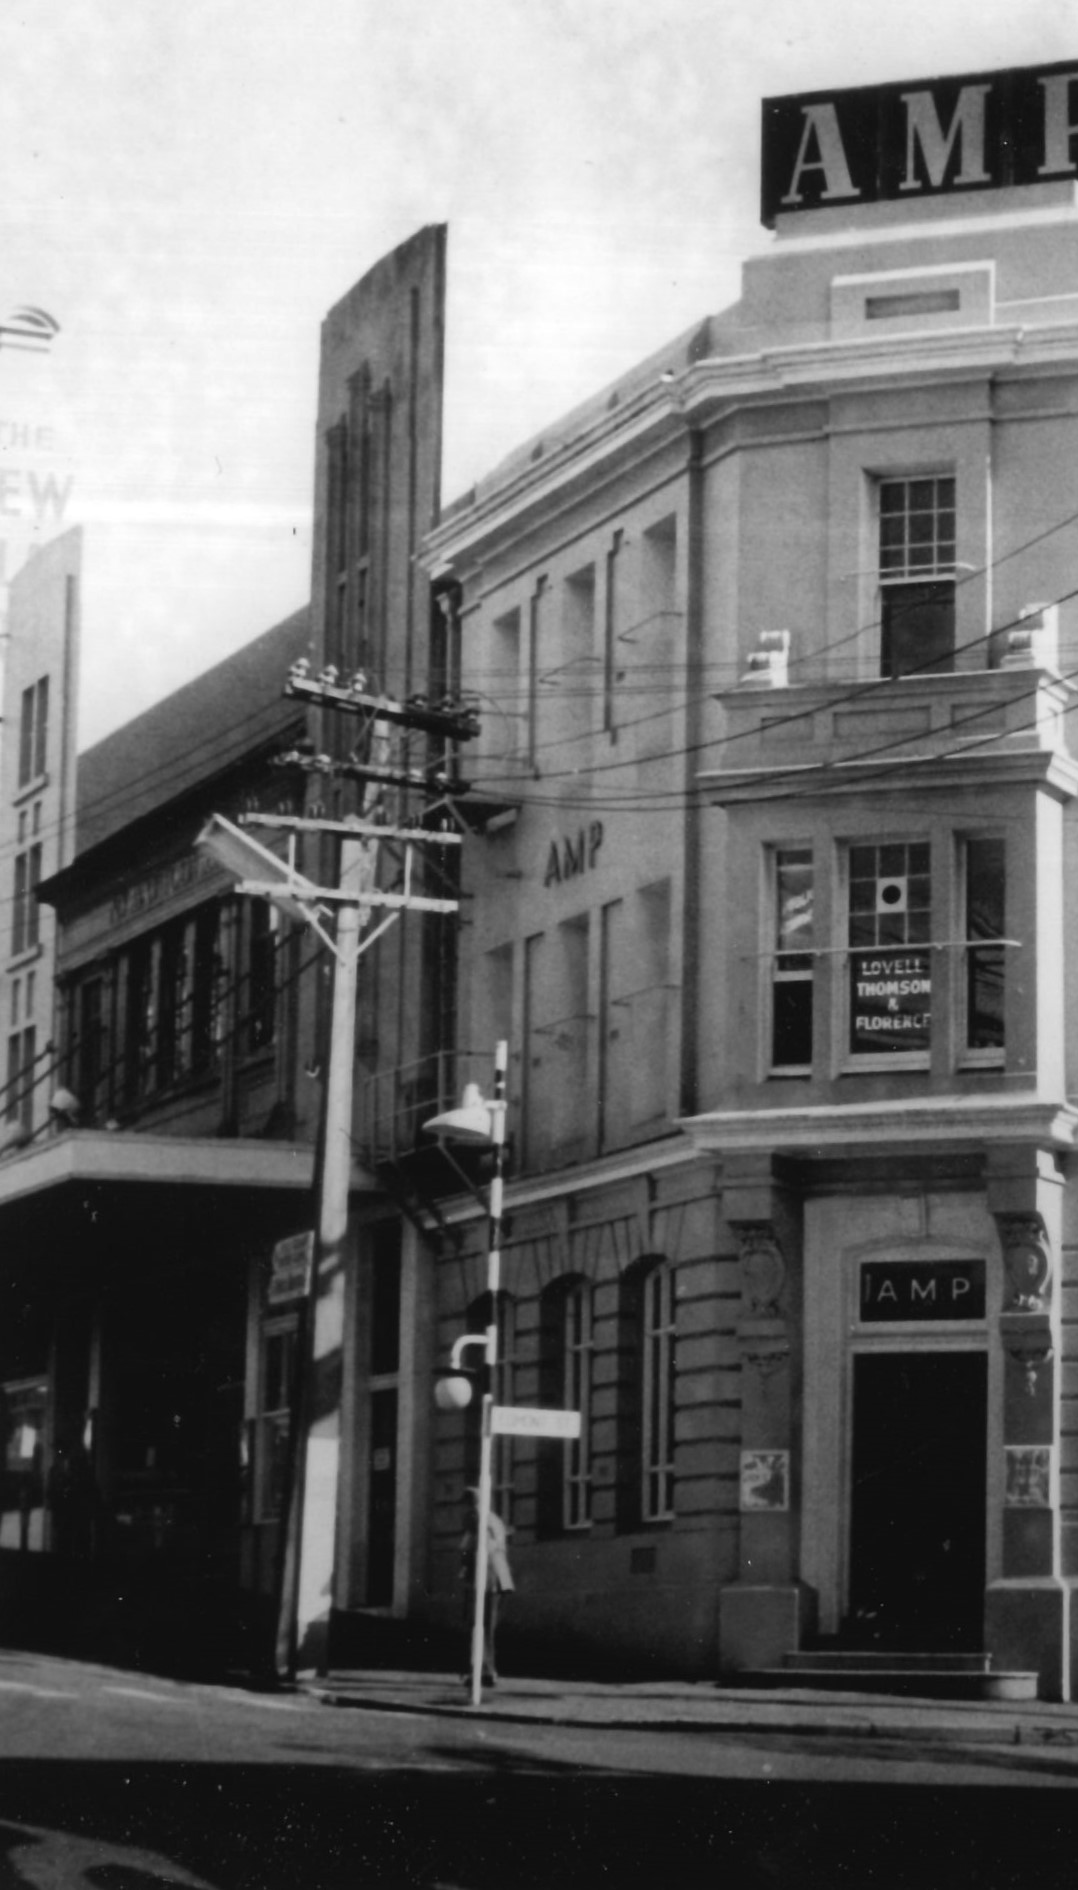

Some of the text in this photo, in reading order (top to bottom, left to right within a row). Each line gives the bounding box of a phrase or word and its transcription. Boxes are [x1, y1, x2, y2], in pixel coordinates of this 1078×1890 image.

[543, 819, 604, 888] AMP
[862, 958, 923, 976] LOVELL
[857, 979, 931, 997] THOMSON
[888, 997, 899, 1011] &
[877, 1277, 970, 1301] AMP
